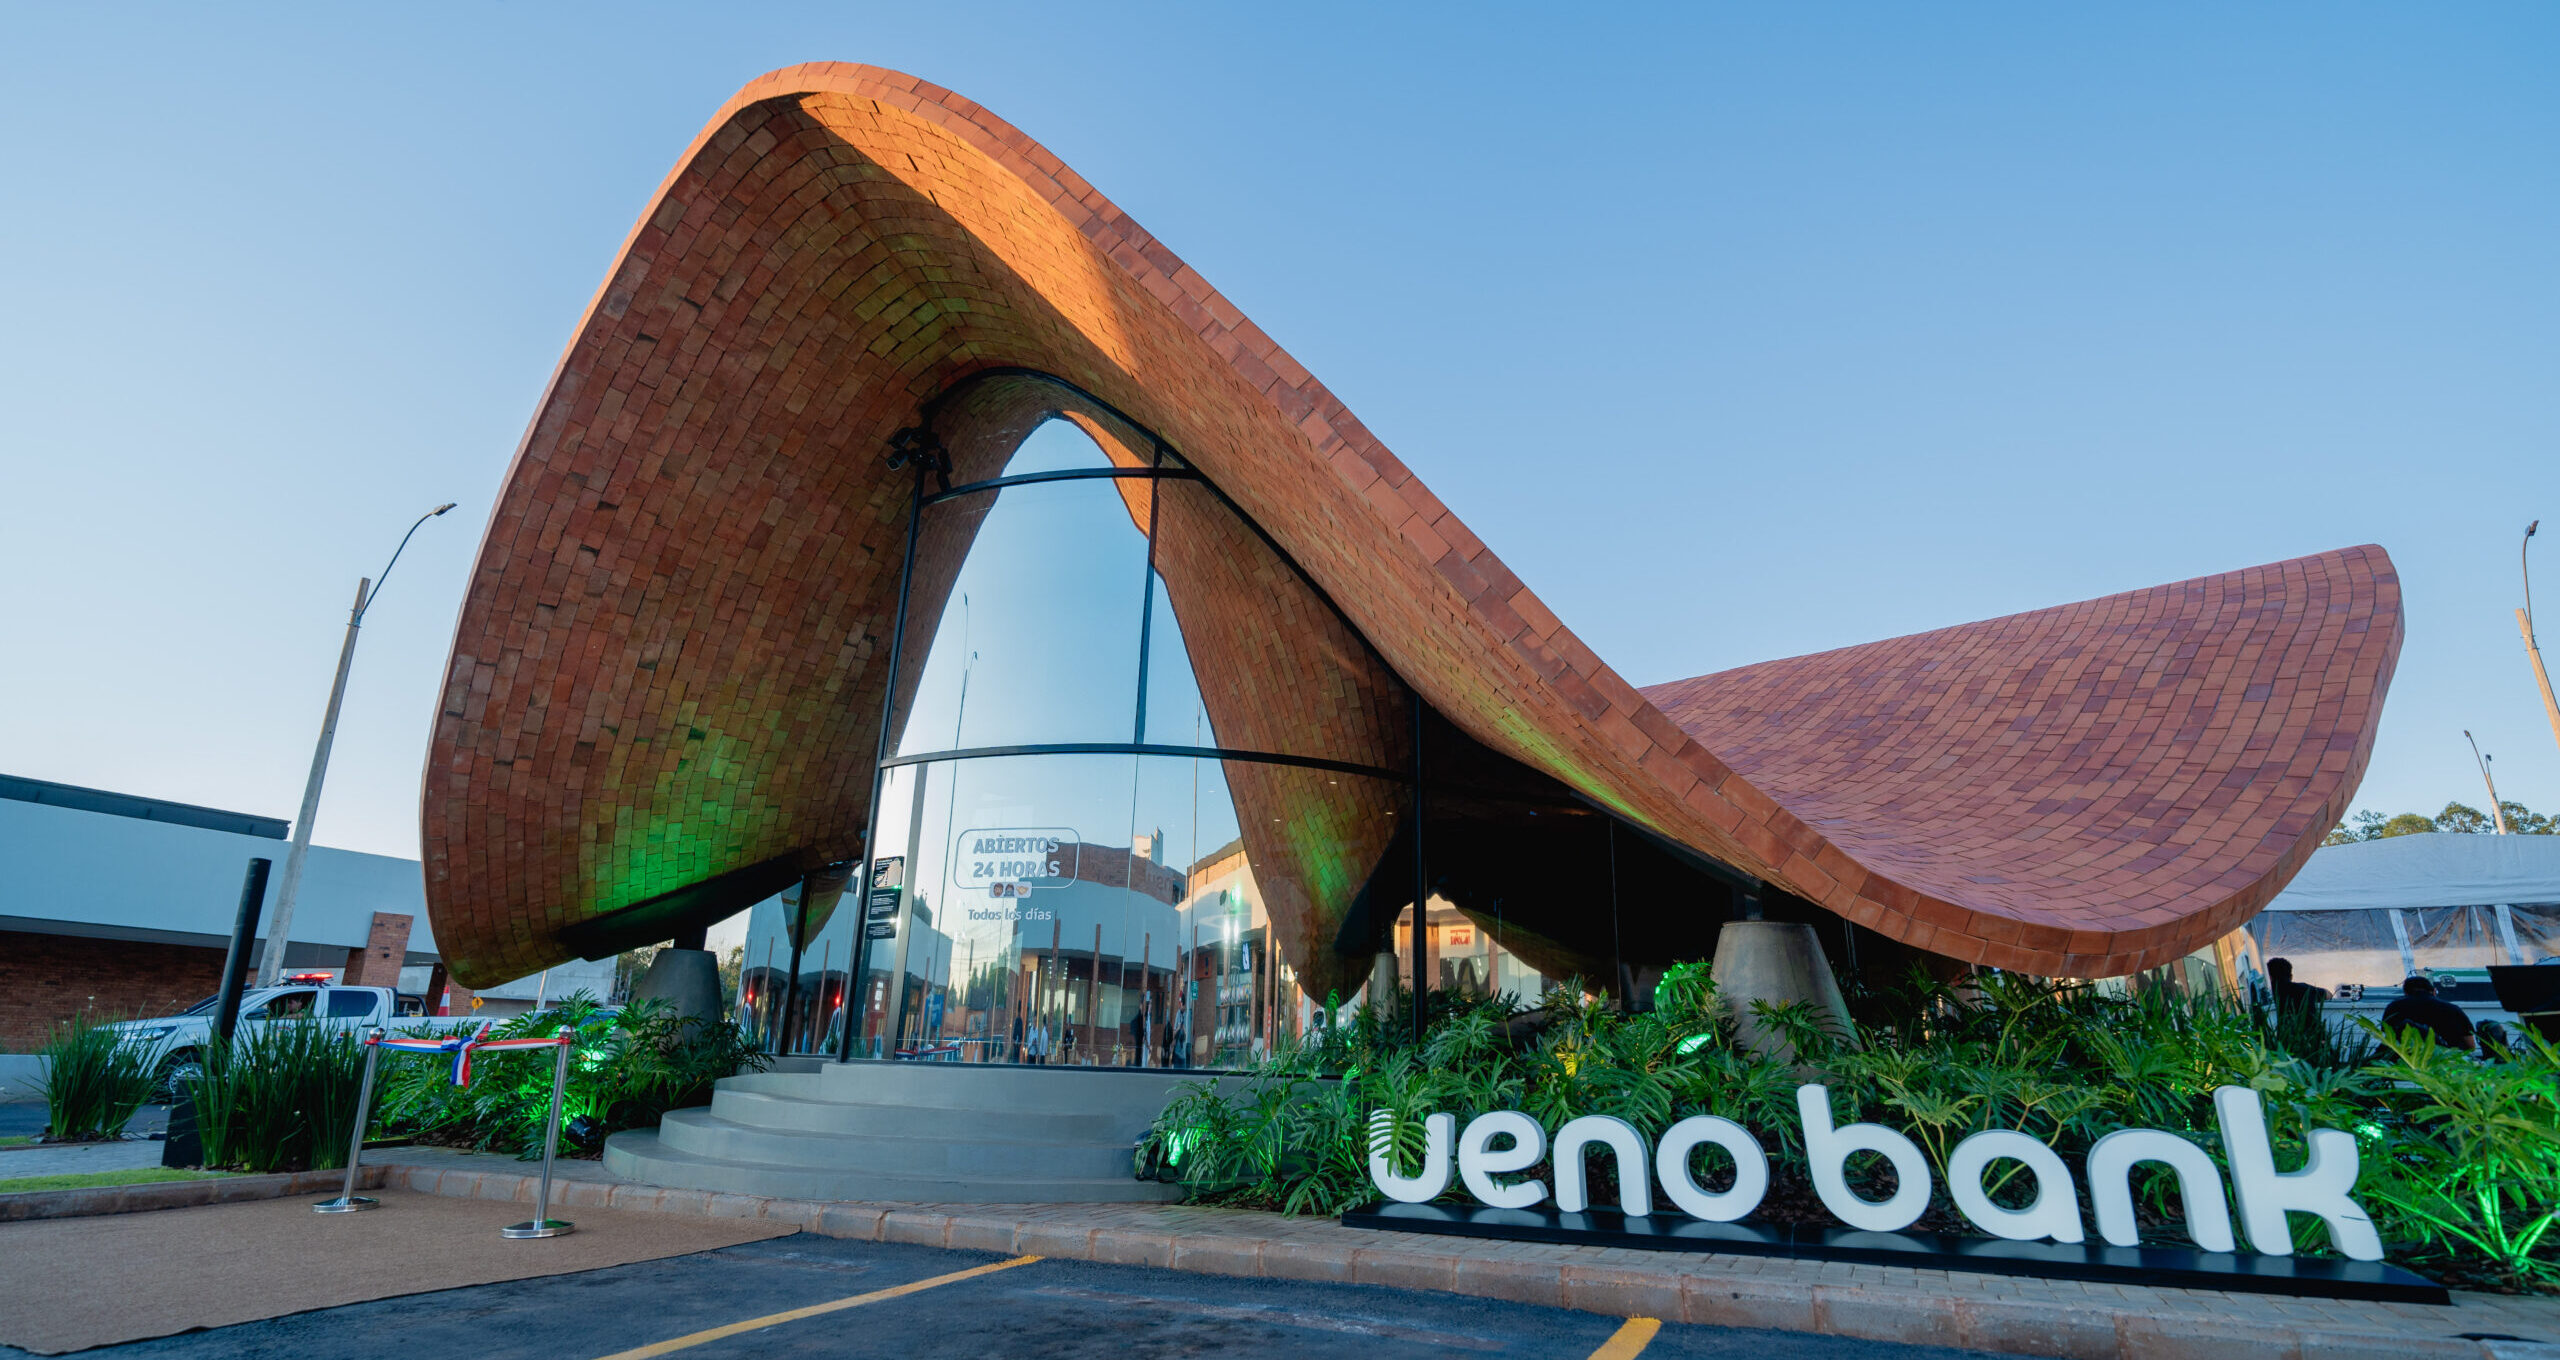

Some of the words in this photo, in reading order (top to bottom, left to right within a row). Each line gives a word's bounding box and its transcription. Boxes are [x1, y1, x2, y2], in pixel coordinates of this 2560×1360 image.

[973, 837, 1060, 854] ABIERTOS
[973, 861, 995, 878] 24
[1000, 860, 1061, 878] HORAS
[968, 908, 1002, 921] Todos
[1004, 908, 1022, 921] los
[1025, 907, 1052, 921] días
[1368, 1109, 1770, 1222] ueno
[1796, 1083, 2385, 1262] bank
